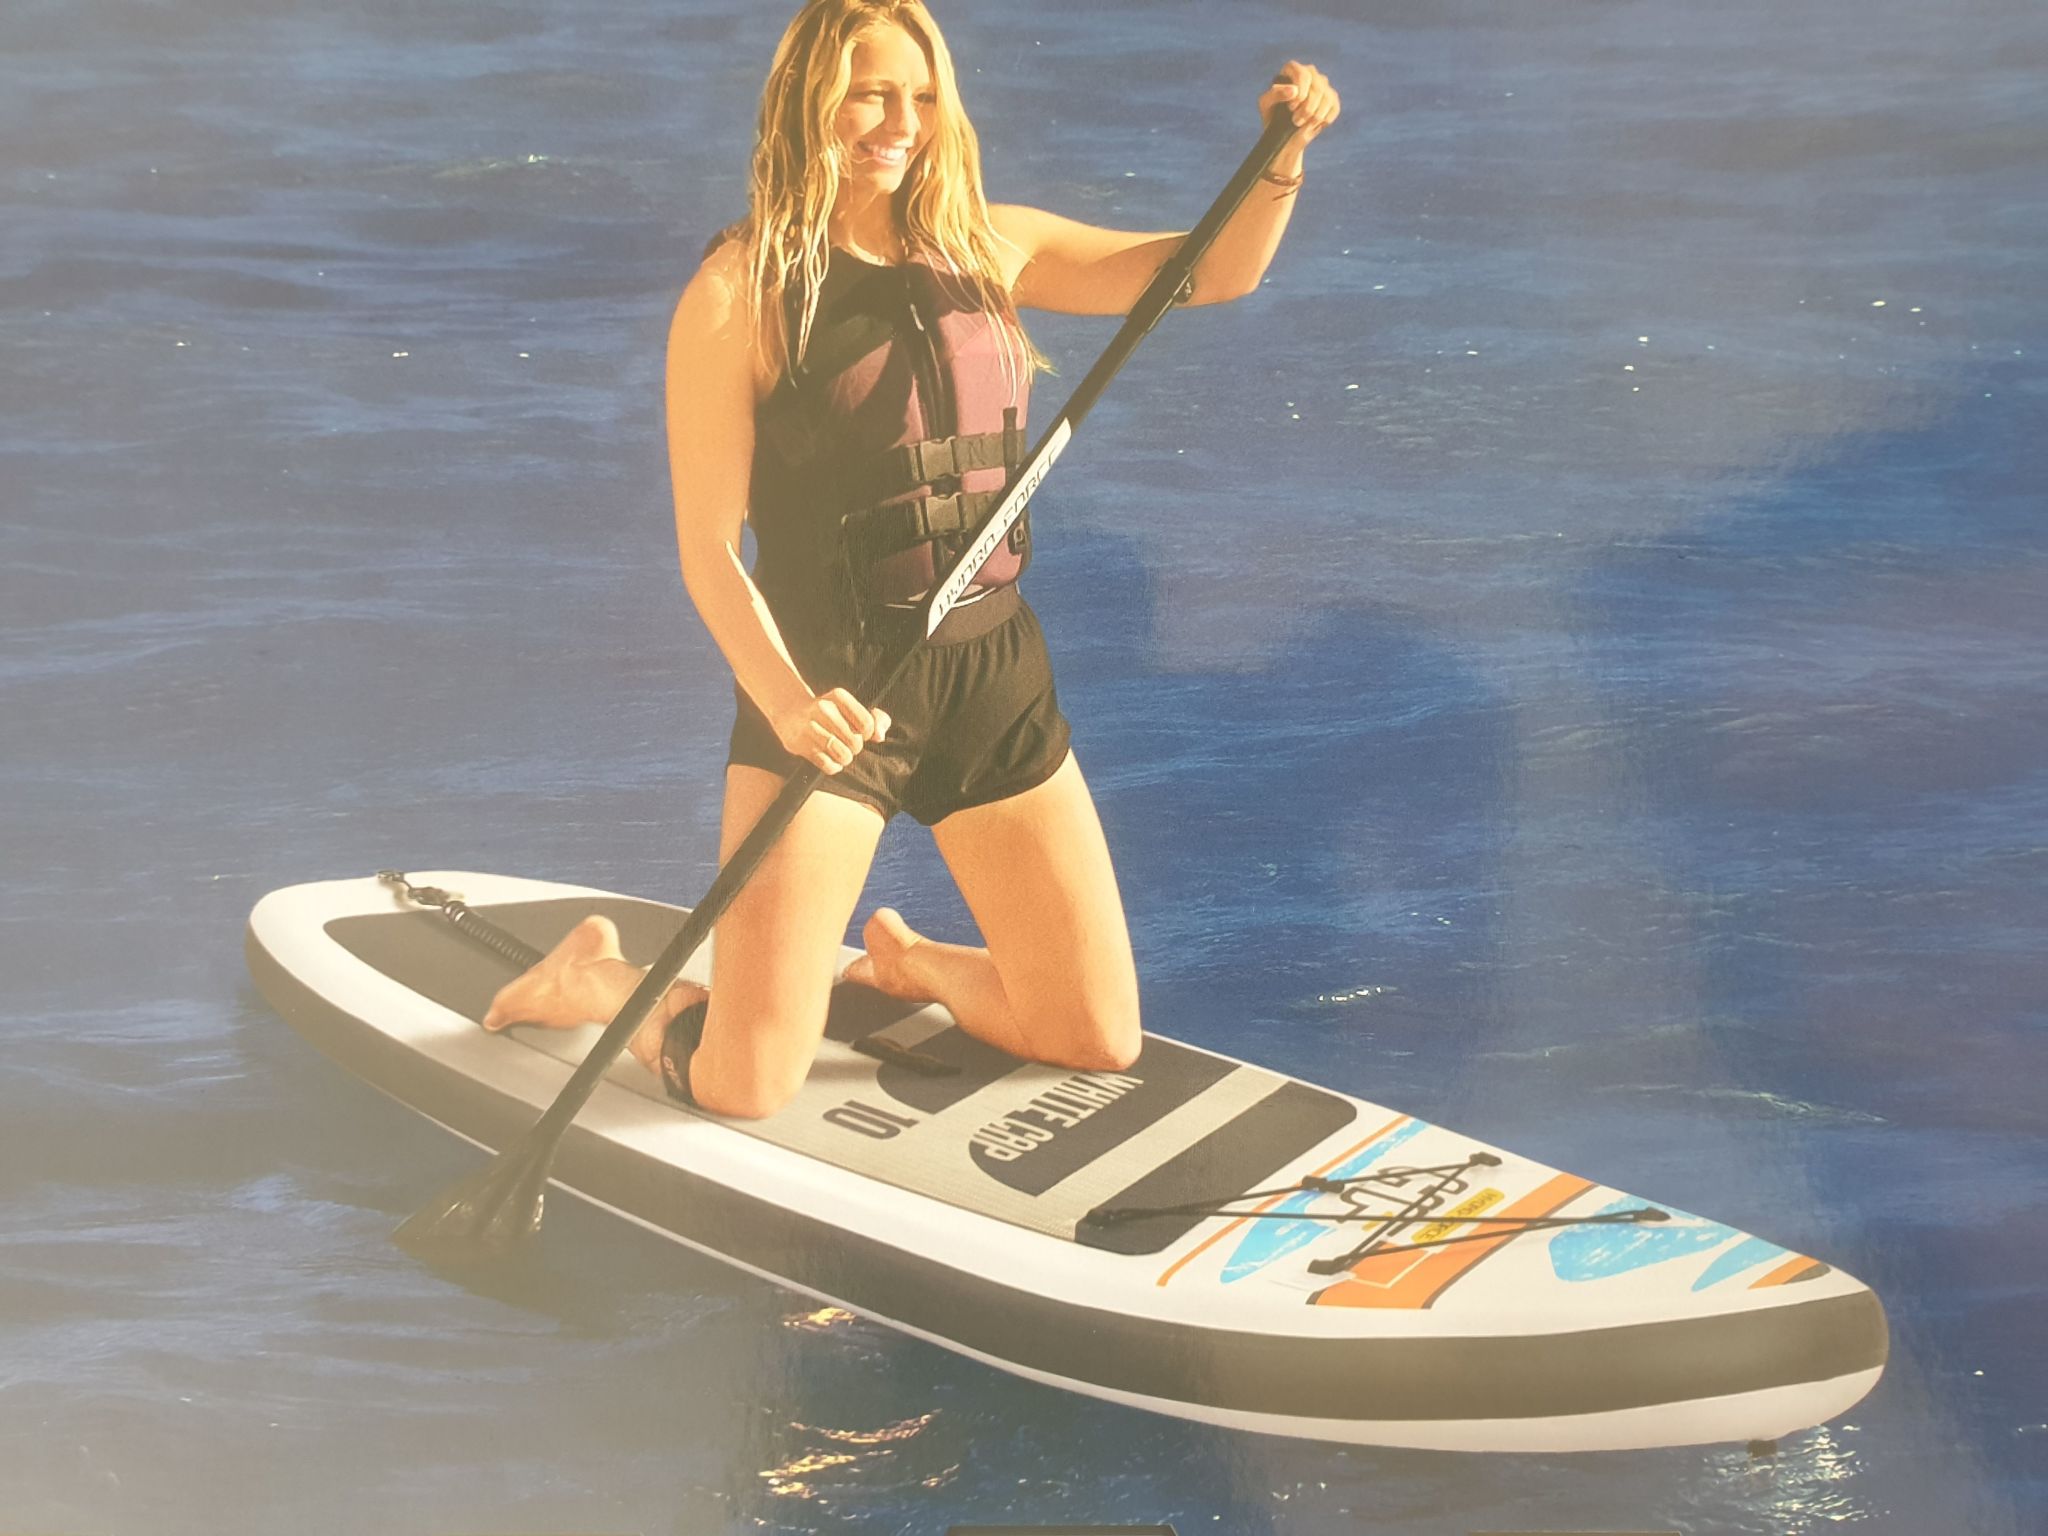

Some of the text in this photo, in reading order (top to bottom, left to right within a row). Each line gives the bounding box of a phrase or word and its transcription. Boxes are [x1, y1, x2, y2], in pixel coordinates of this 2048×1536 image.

[822, 1099, 920, 1140] 10
[971, 1071, 1145, 1162] WHITE CAP
